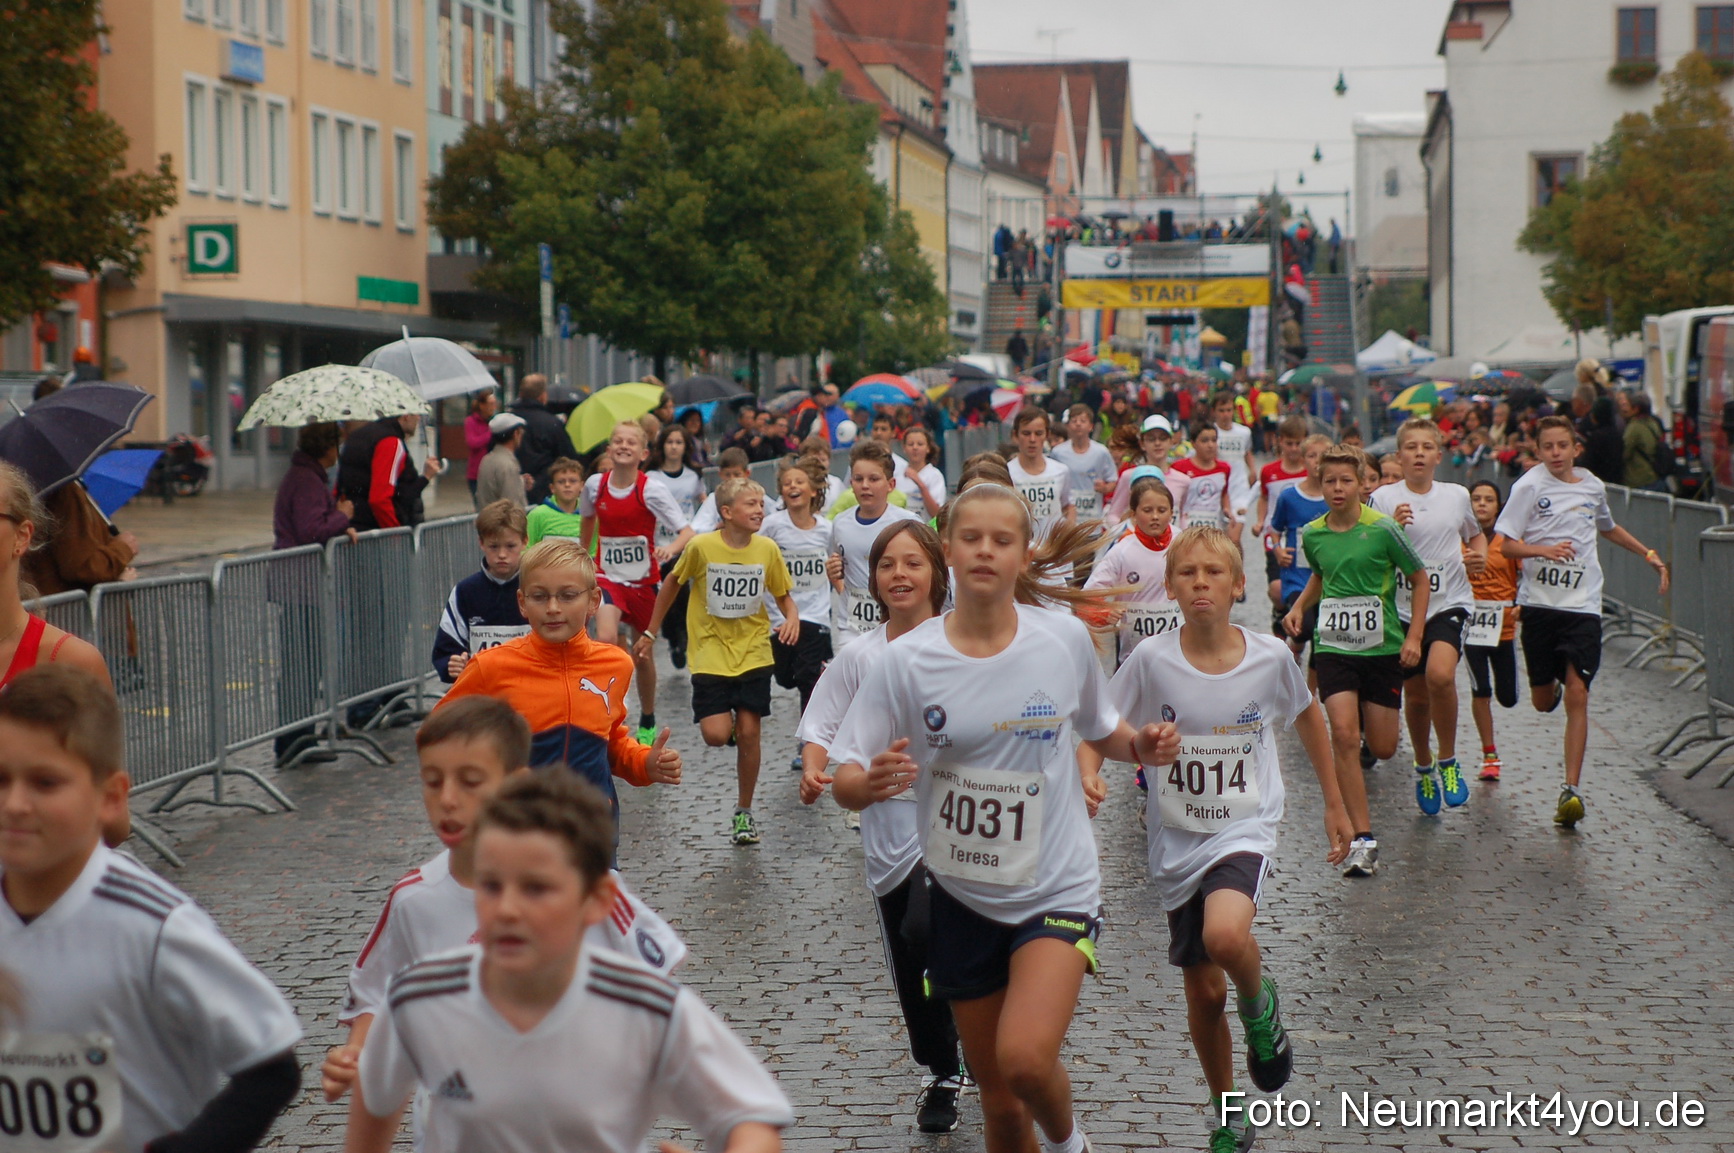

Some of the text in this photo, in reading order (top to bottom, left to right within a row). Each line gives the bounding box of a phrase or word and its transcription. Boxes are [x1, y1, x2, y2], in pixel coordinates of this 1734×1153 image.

[194, 230, 230, 267] D
[1130, 285, 1199, 302] START
[605, 546, 644, 565] 4050
[708, 567, 727, 575] PARTL
[1537, 567, 1584, 589] 4047
[712, 577, 759, 597] 4020
[722, 602, 746, 610] Justus
[1133, 616, 1178, 636] 4024
[1325, 610, 1377, 632] 4018
[1336, 634, 1366, 645] Gabriel
[925, 732, 952, 743] PARTL
[1191, 745, 1240, 755] Neumarkt
[932, 770, 961, 787] PARTL
[963, 778, 1021, 794] Neumarkt
[1167, 760, 1247, 796] 4014
[939, 789, 1025, 841] 4031
[1186, 803, 1230, 820] Patrick
[950, 843, 999, 868] Teresa
[1044, 916, 1085, 931] hummel
